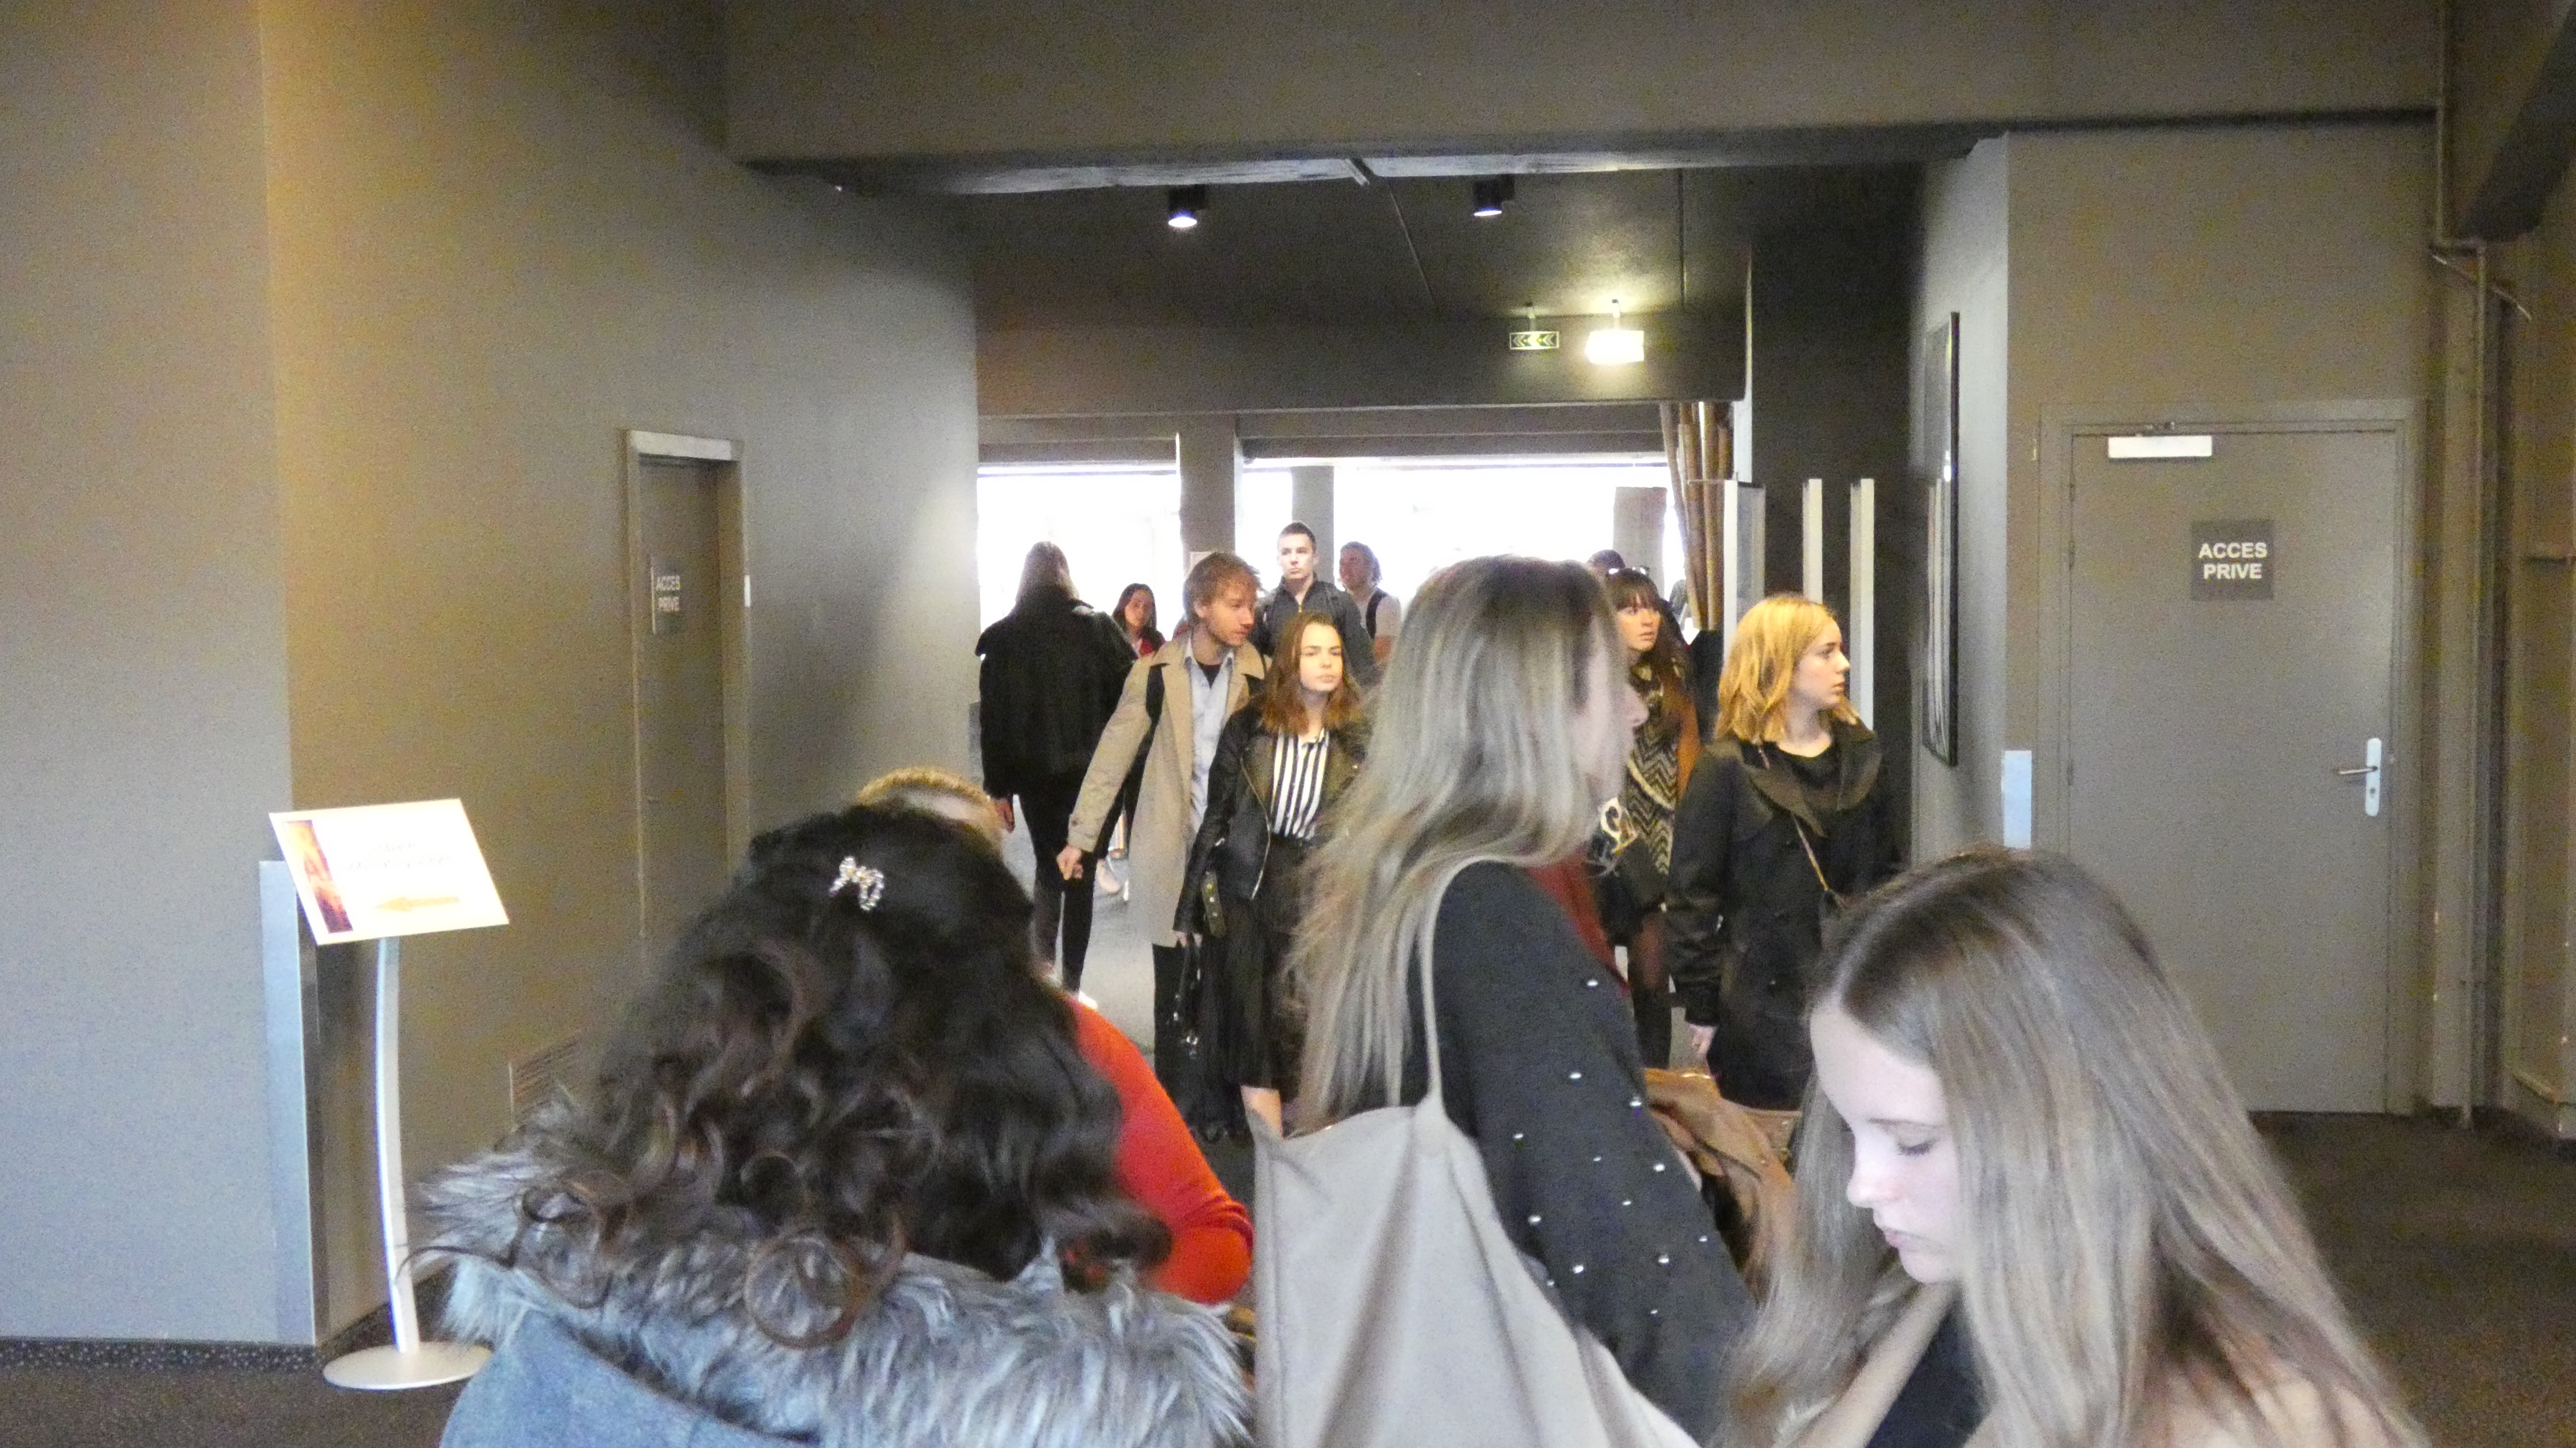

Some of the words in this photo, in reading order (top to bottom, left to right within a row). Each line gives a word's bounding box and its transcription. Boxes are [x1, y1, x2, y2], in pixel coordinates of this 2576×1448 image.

[2198, 542, 2268, 559] ACCES
[2203, 563, 2262, 579] PRIVE
[656, 575, 681, 591] ACCES
